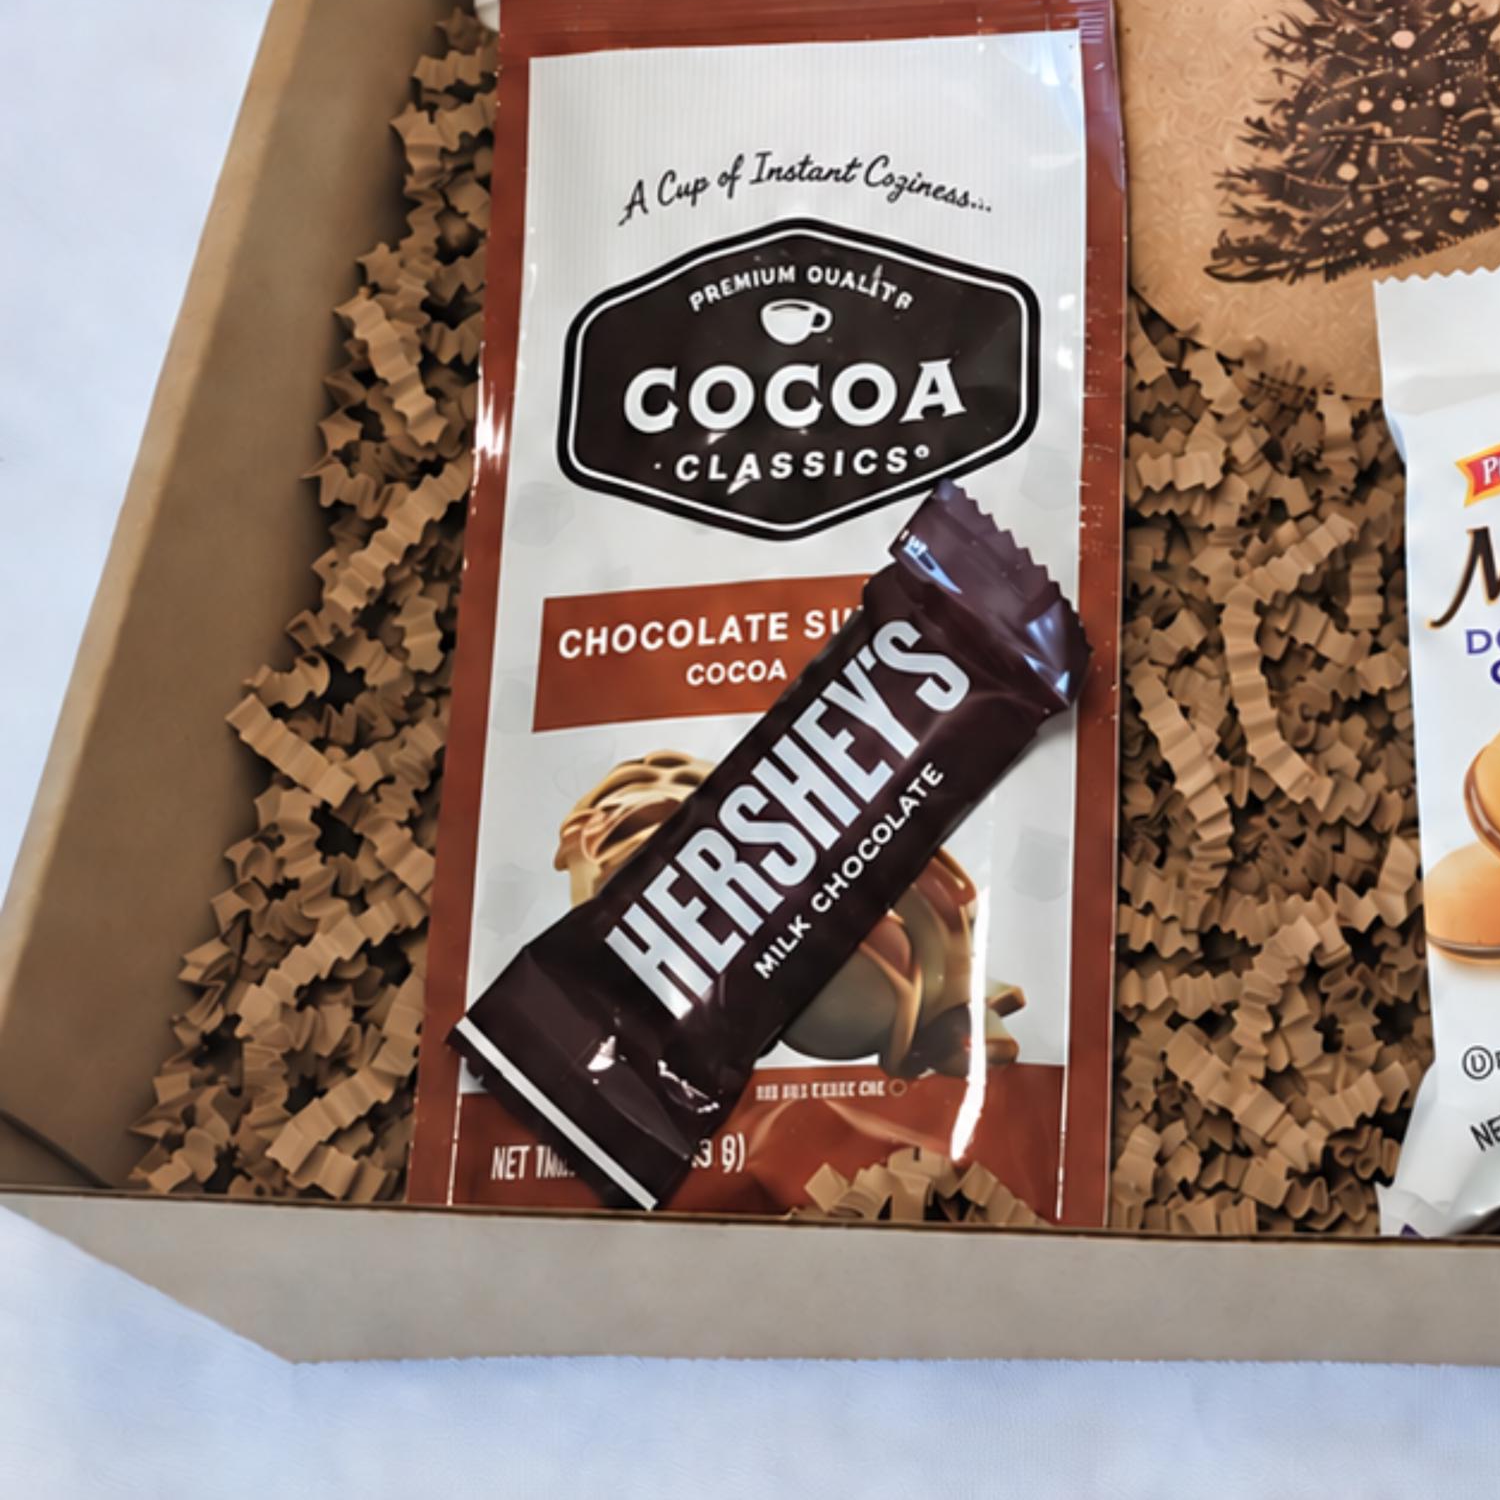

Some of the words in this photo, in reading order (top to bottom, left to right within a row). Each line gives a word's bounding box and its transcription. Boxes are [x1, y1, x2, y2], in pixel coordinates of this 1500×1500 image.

[618, 178, 648, 226] A
[657, 170, 709, 207] Cup
[717, 154, 744, 199] of
[749, 151, 862, 186] Instant
[689, 265, 796, 312] PREMIUM
[623, 358, 966, 434] COCOA
[559, 611, 789, 659] CHOCOLATE
[686, 658, 787, 686] COCOA
[605, 620, 970, 1020] HERSHEY'S
[754, 918, 812, 979] MILK
[811, 762, 943, 911] CHOCOLATE
[491, 1145, 530, 1181] NET
